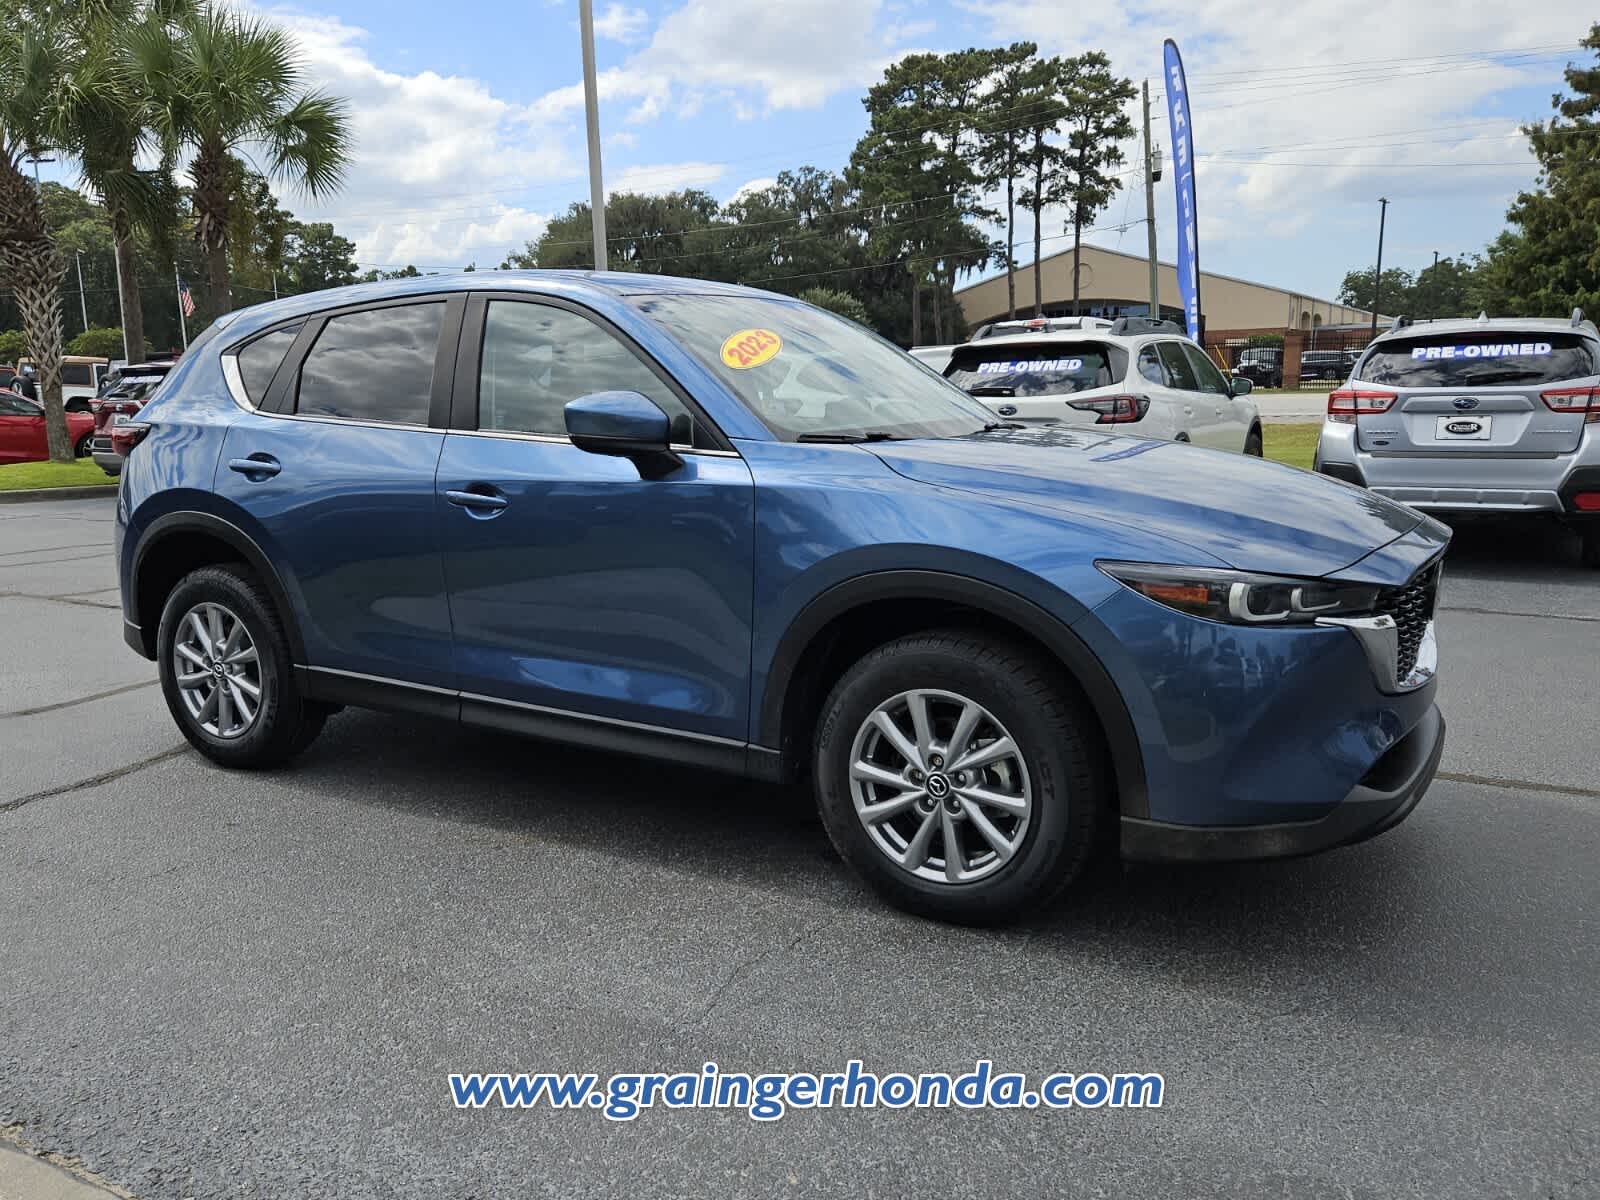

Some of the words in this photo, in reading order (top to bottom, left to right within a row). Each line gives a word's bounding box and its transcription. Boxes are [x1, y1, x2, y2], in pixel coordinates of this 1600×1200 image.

[727, 330, 777, 366] 2023
[1411, 343, 1552, 359] PRE-OWNED
[977, 359, 1083, 374] PRE-OWNED
